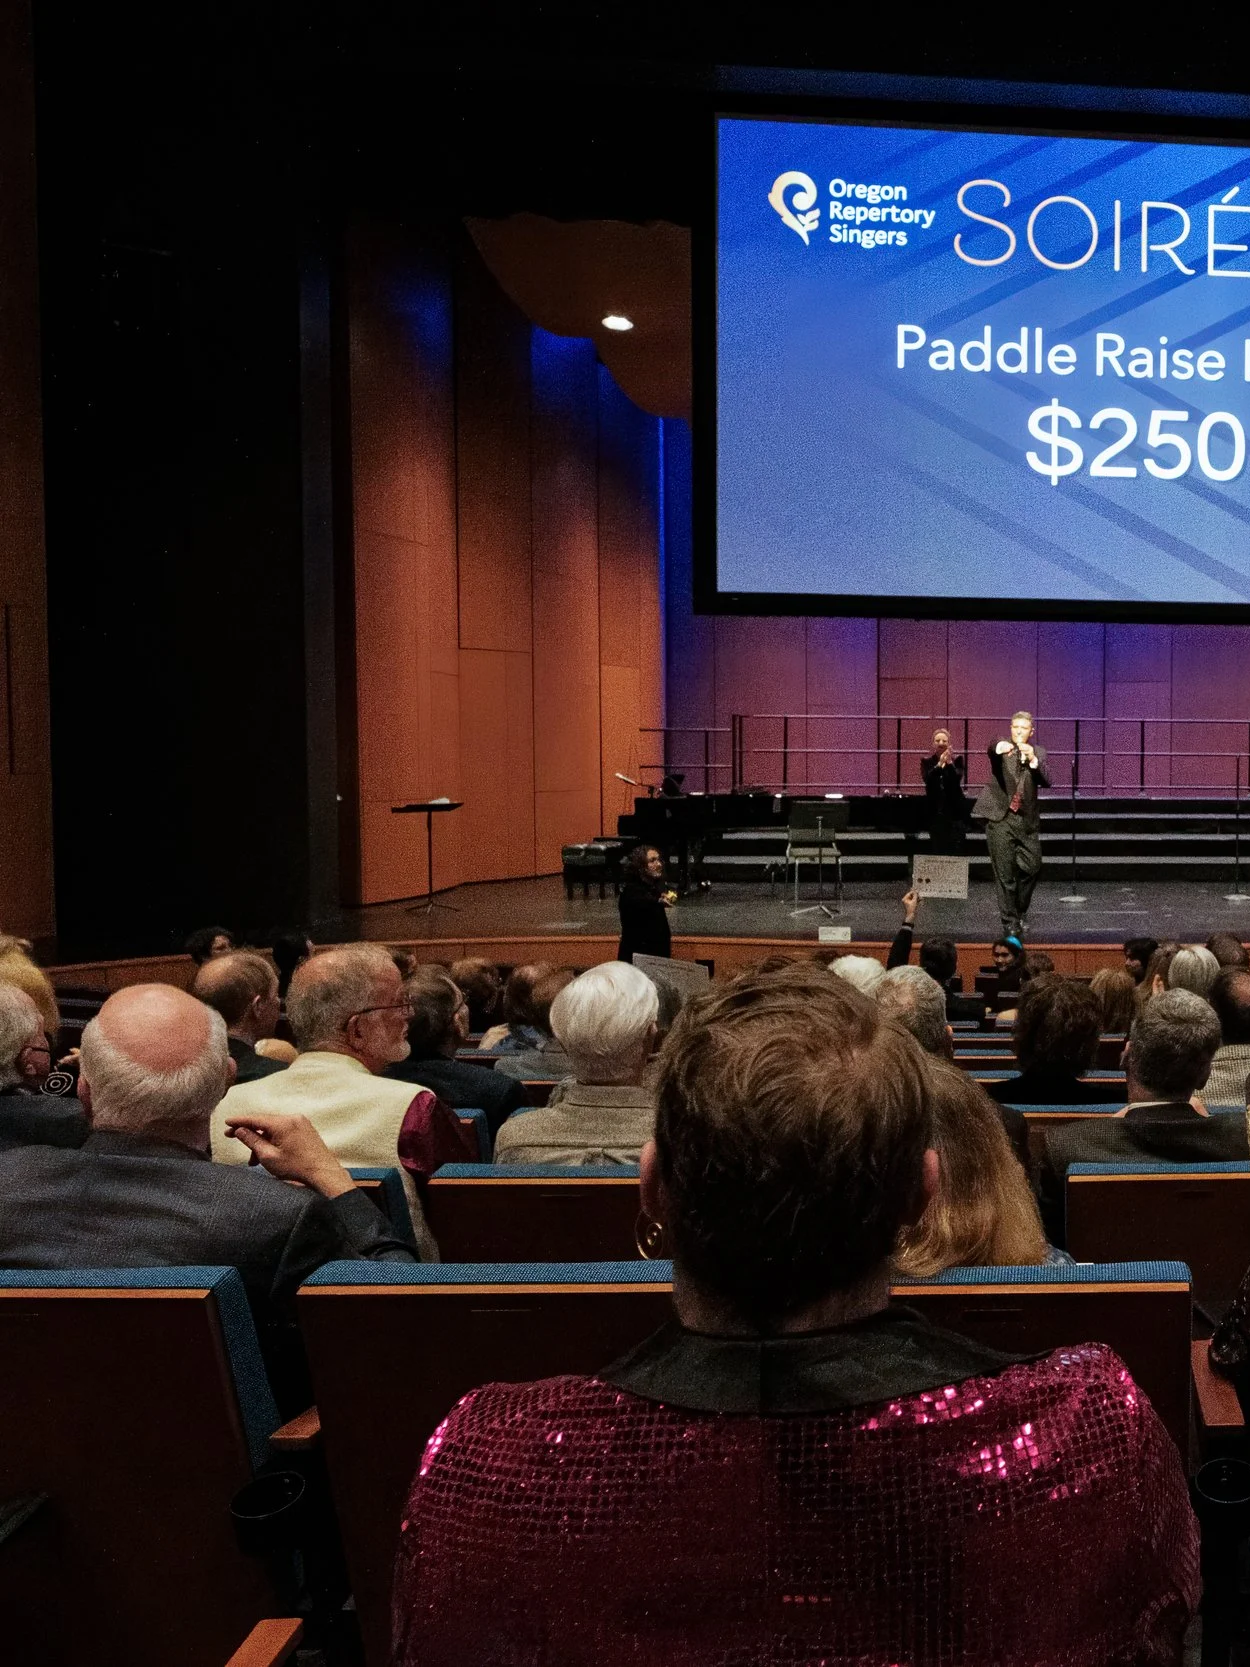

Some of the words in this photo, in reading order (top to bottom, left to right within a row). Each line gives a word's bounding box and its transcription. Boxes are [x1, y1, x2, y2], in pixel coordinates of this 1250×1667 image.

[829, 178, 908, 204] Oregon
[829, 201, 937, 229] Repertory
[829, 223, 909, 249] Singers
[896, 323, 1077, 375] Paddle
[1094, 331, 1227, 382] Raise
[1025, 397, 1248, 487] $250
